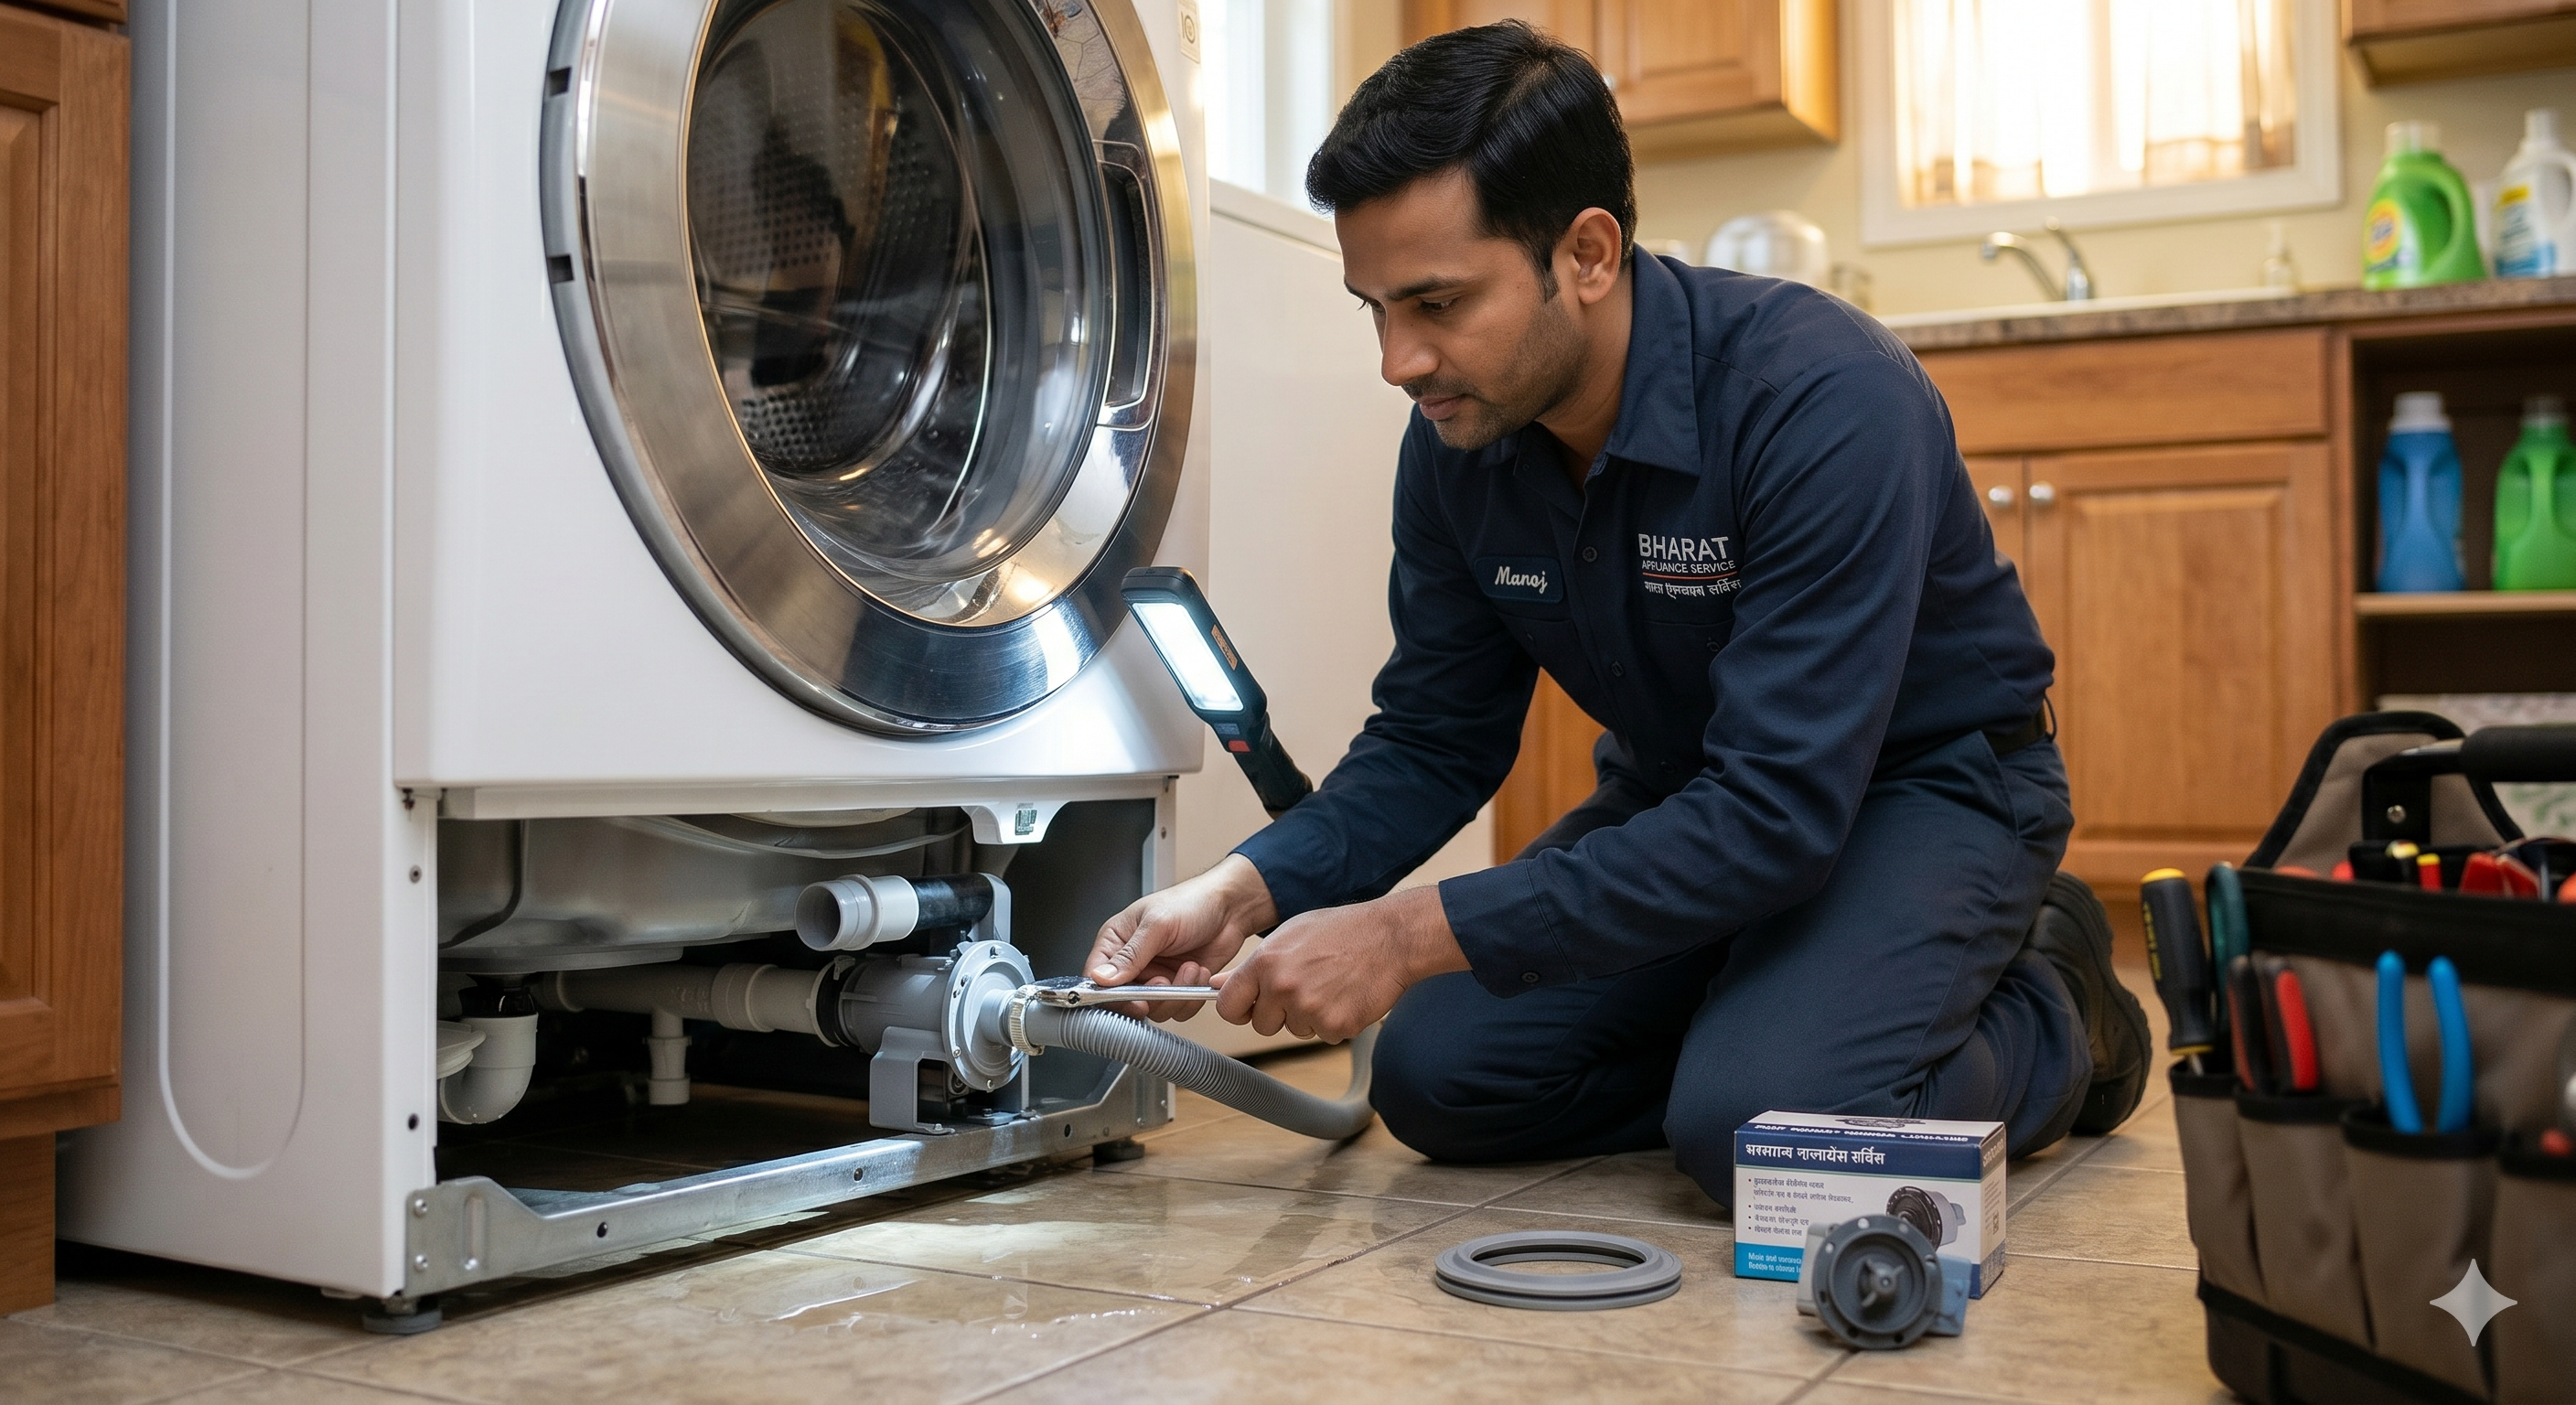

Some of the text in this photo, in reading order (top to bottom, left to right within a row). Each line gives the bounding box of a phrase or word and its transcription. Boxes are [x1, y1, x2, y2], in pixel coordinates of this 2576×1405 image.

[1637, 533, 1729, 562] BHARAT
[1494, 565, 1548, 595] Manoj
[1690, 560, 1736, 574] SERVICE
